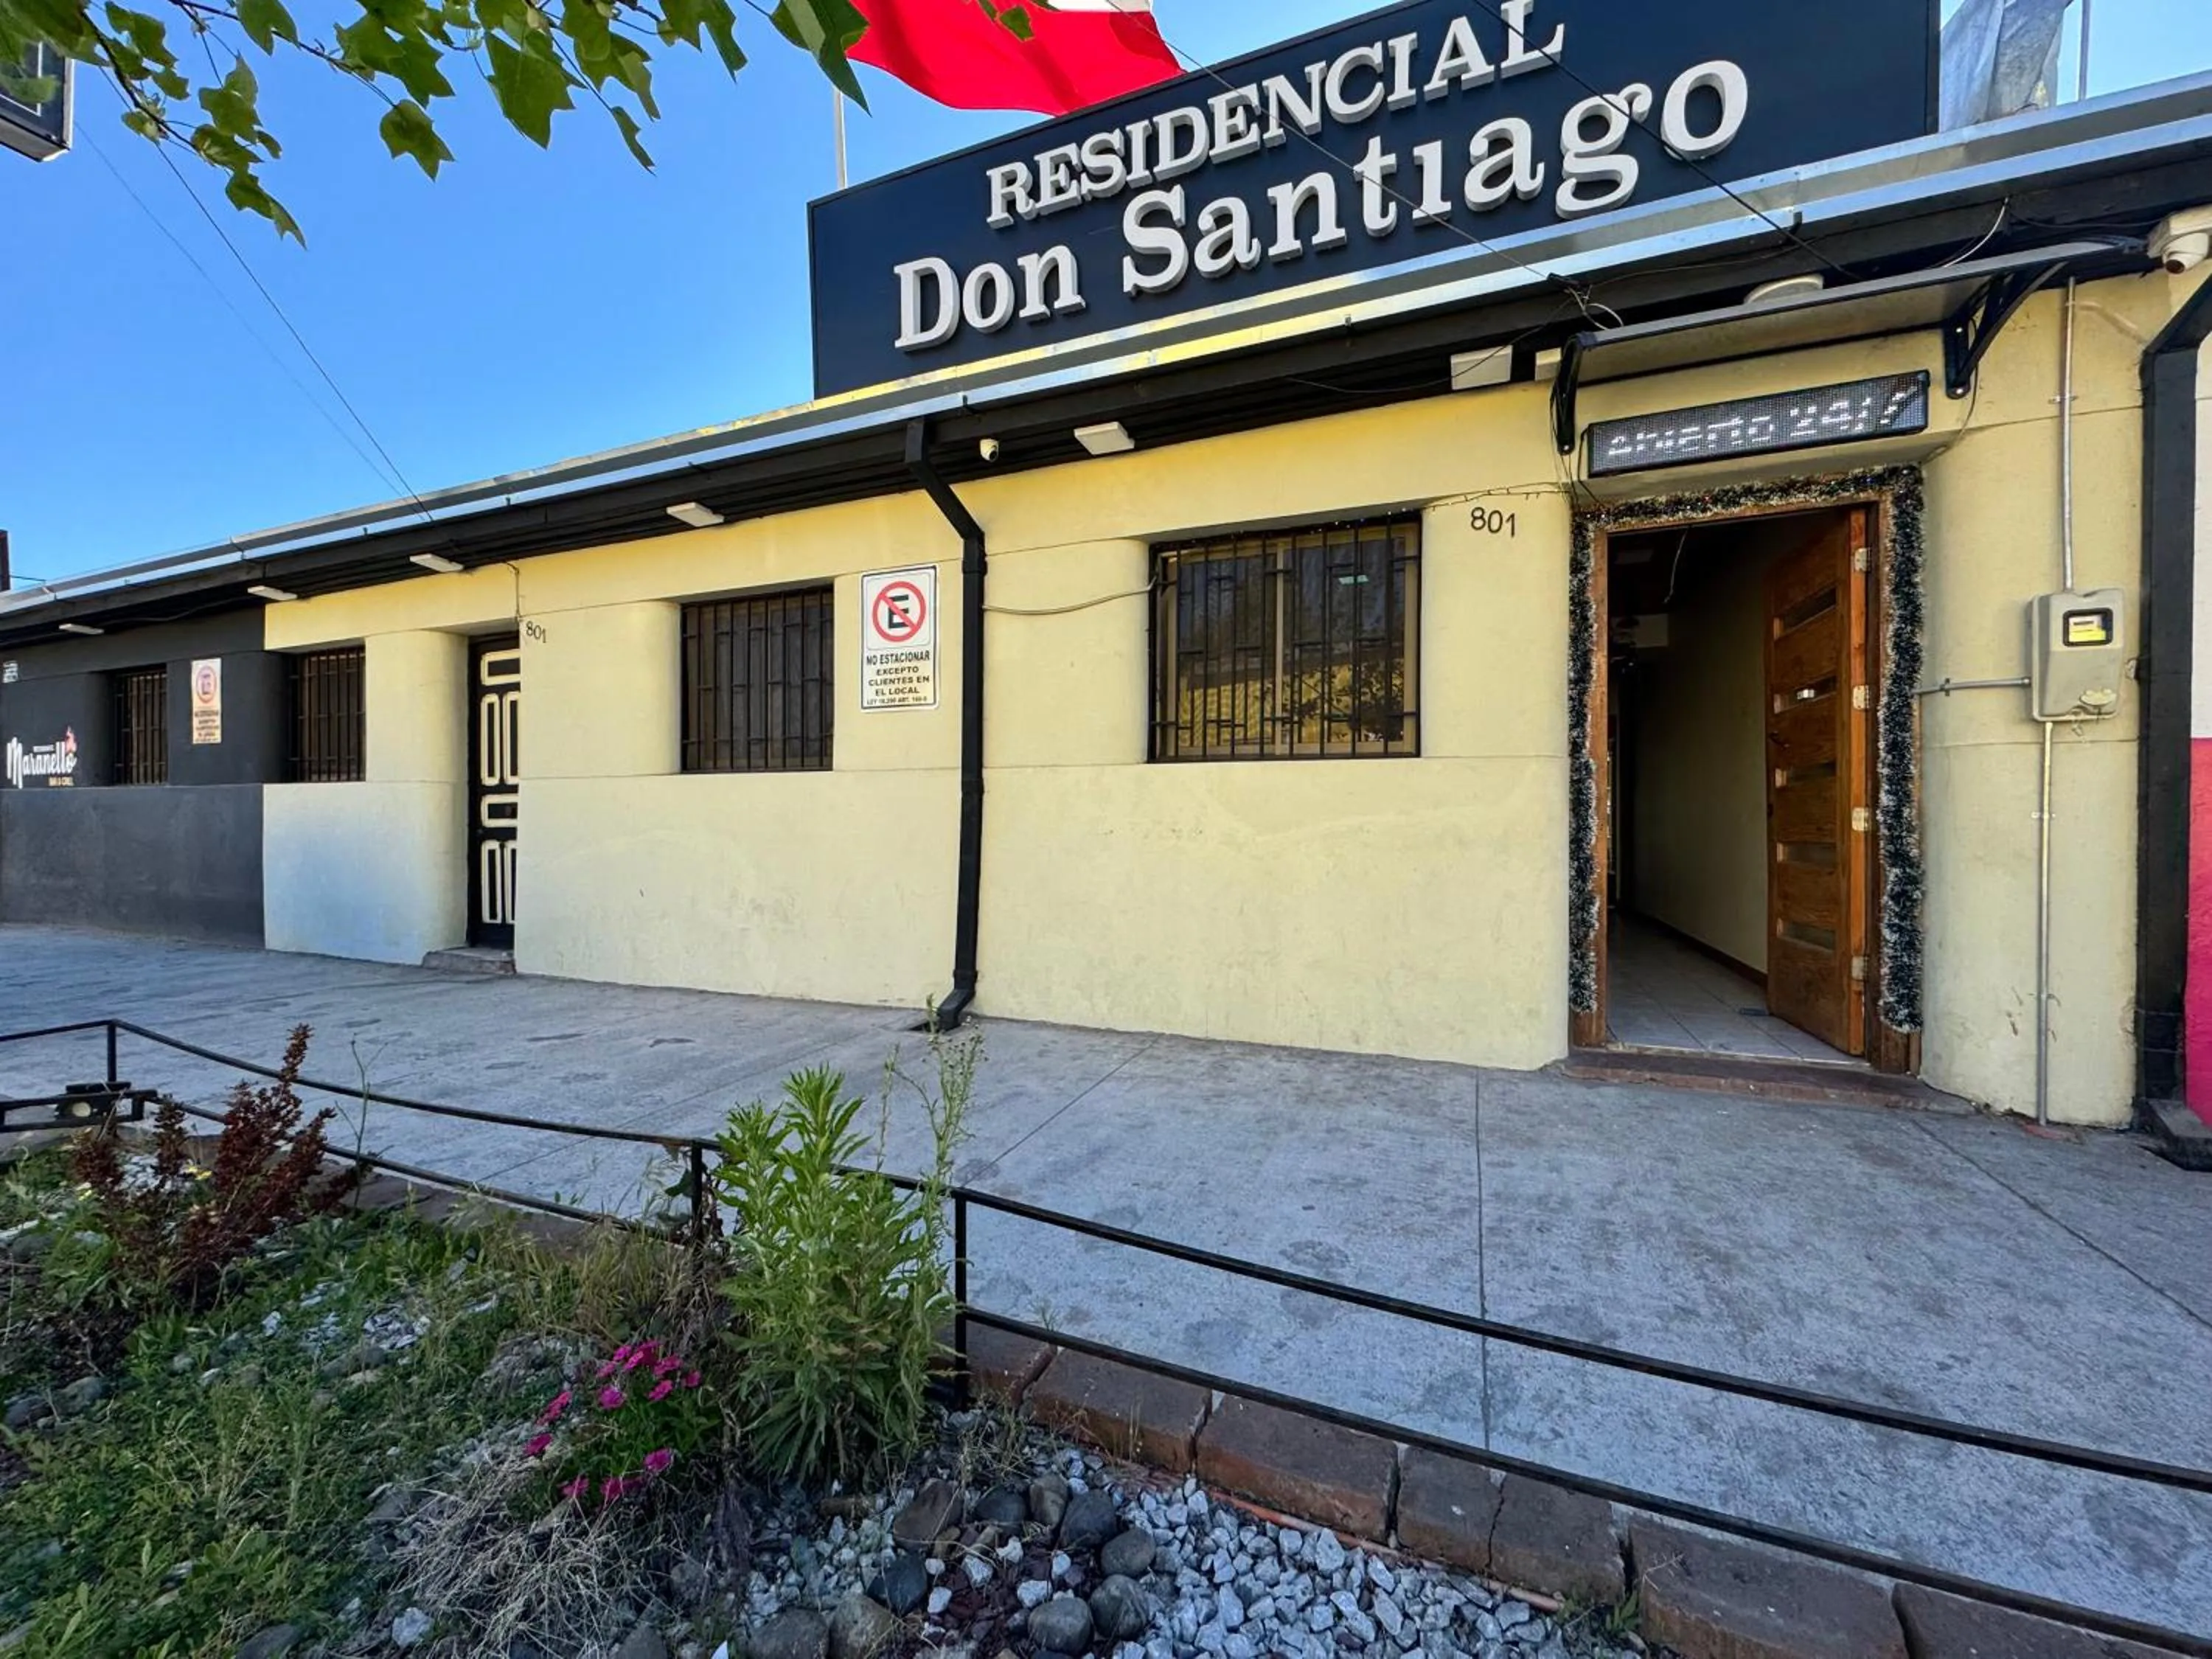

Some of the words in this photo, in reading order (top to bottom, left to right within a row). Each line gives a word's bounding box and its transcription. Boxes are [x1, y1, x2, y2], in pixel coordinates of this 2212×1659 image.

[987, 0, 1565, 229] RESIDENCIAL
[893, 244, 1087, 352] Don
[1121, 60, 1748, 297] Santiago
[1470, 507, 1515, 538] 801
[525, 620, 547, 644] 801
[866, 655, 877, 666] NO
[880, 650, 931, 665] ESTACIONAR
[868, 676, 914, 686] CLIENTES
[917, 675, 931, 684] EN
[876, 665, 919, 676] EXCEPTO
[875, 688, 886, 697] EL
[888, 686, 920, 695] LOCAL
[7, 736, 77, 789] Maranello
